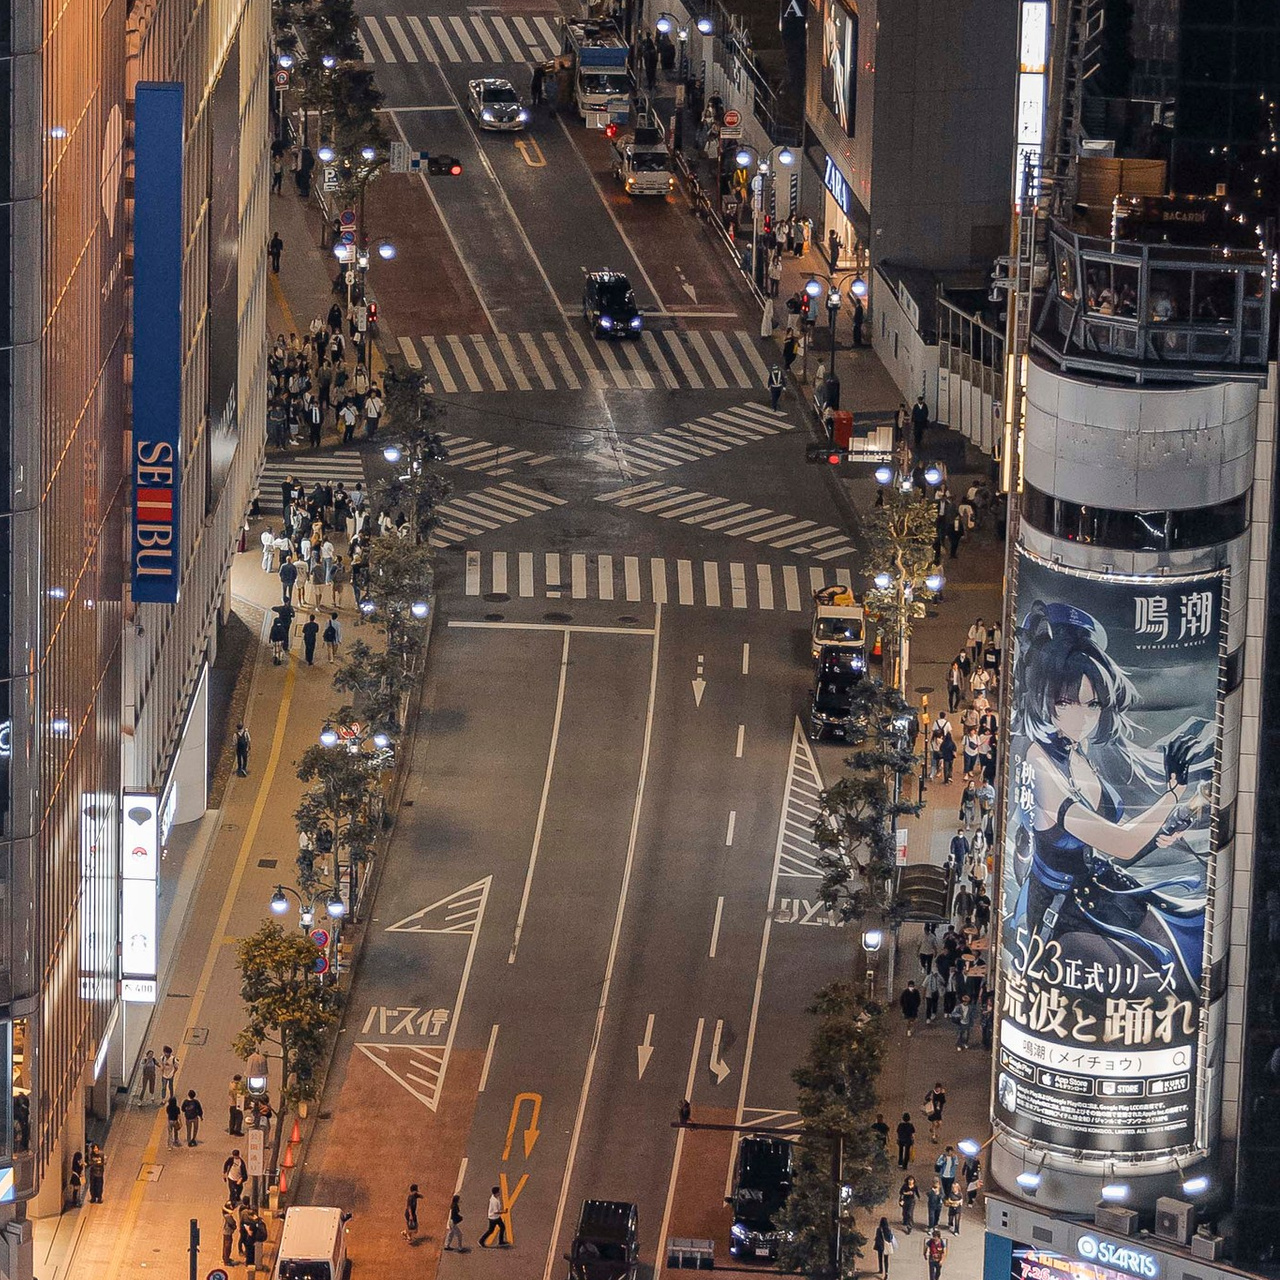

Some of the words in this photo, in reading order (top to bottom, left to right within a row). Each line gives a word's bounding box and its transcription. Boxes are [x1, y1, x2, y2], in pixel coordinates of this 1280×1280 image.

[825, 155, 849, 213] ZARA
[136, 441, 173, 577] SEIBU
[1133, 591, 1213, 643] 鳴潮
[361, 1006, 449, 1035] バス停
[1003, 973, 1196, 1046] 荒波と踊れ
[1054, 1075, 1068, 1084] App
[1068, 1076, 1088, 1087] Store
[1117, 1084, 1139, 1094] STORE
[1164, 1077, 1186, 1087] KURO
